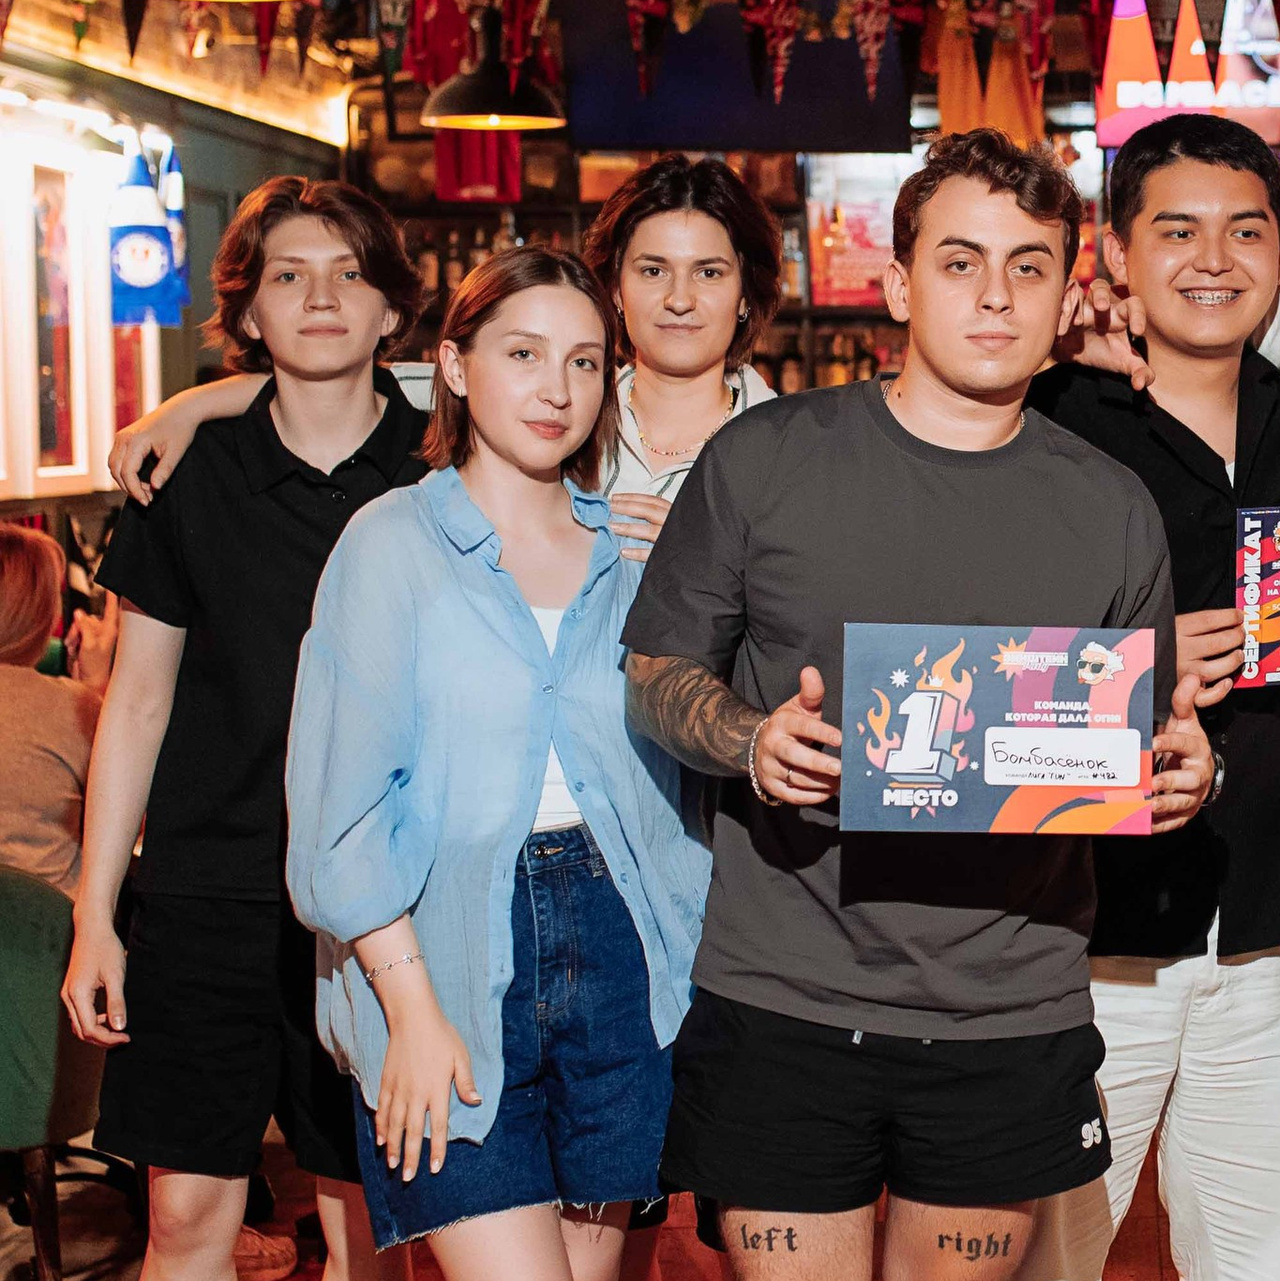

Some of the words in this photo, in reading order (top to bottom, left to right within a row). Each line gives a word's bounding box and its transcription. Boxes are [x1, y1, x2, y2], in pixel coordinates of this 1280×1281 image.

[1241, 517, 1262, 679] СЕРТИФИКАТ
[1267, 588, 1279, 596] НА
[1005, 712, 1057, 722] КОТОРАЯ
[1058, 713, 1092, 724] ДАЛА
[885, 691, 952, 776] 1
[882, 788, 959, 807] МЕСТО
[740, 1223, 799, 1253] left
[938, 1230, 1012, 1261] right
